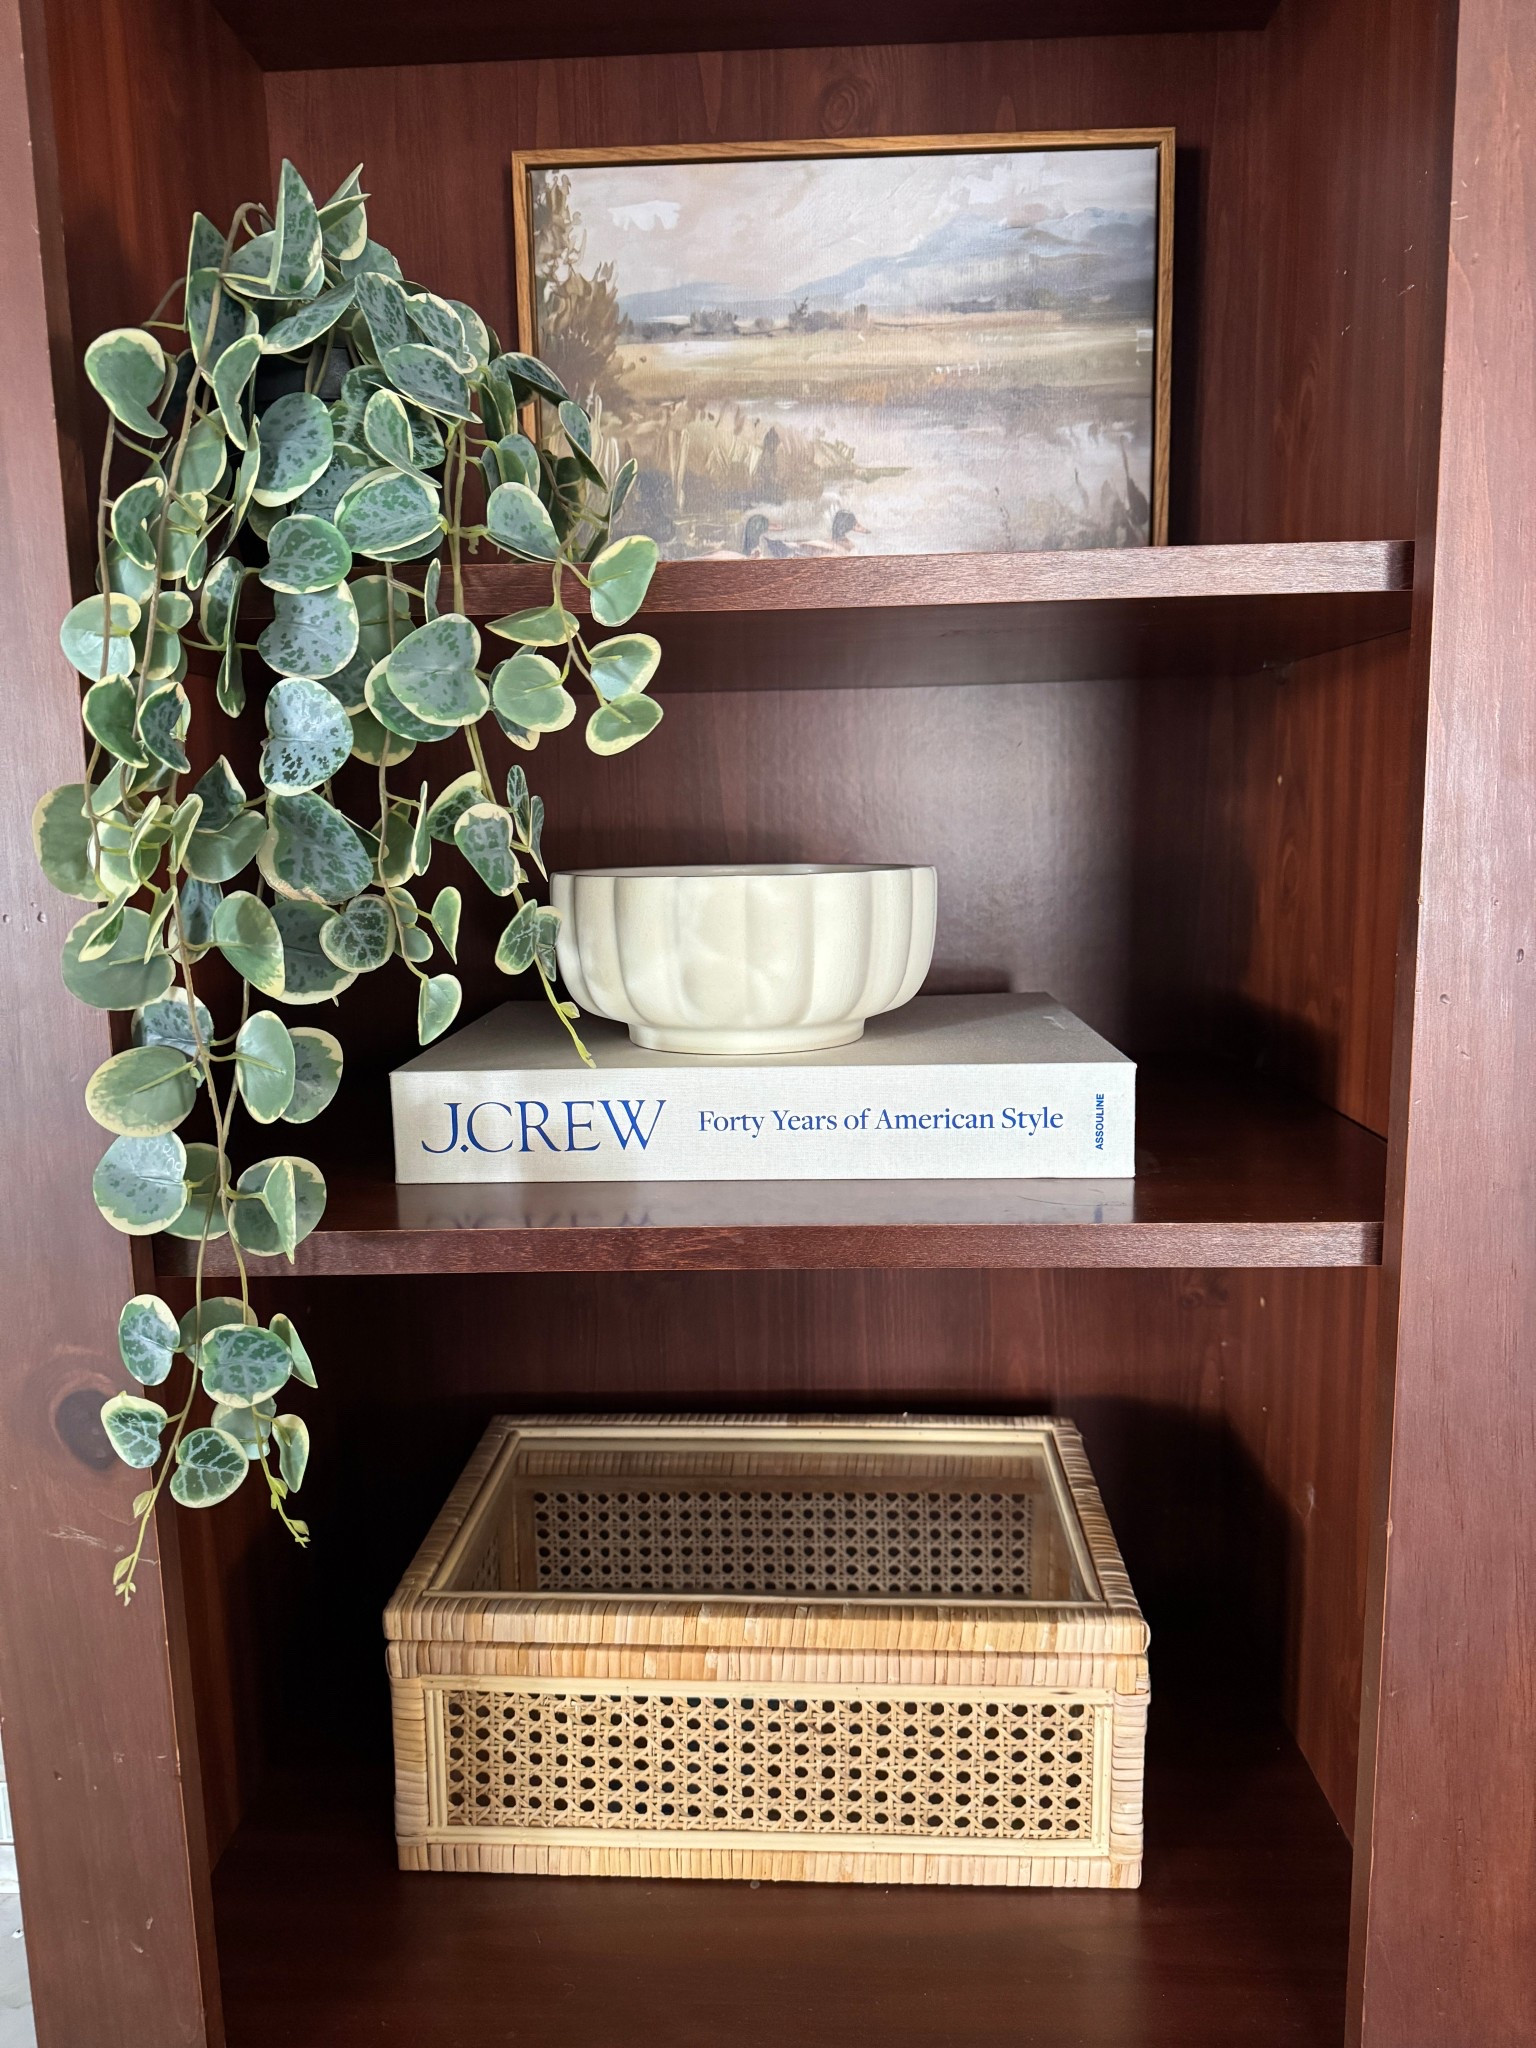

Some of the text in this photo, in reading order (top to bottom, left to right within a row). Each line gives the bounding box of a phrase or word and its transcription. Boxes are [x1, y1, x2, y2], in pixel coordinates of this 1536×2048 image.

[421, 1099, 667, 1153] J.CREW
[698, 1105, 1065, 1138] Forty Years of American Style
[1095, 1093, 1105, 1151] ASSOULINE
